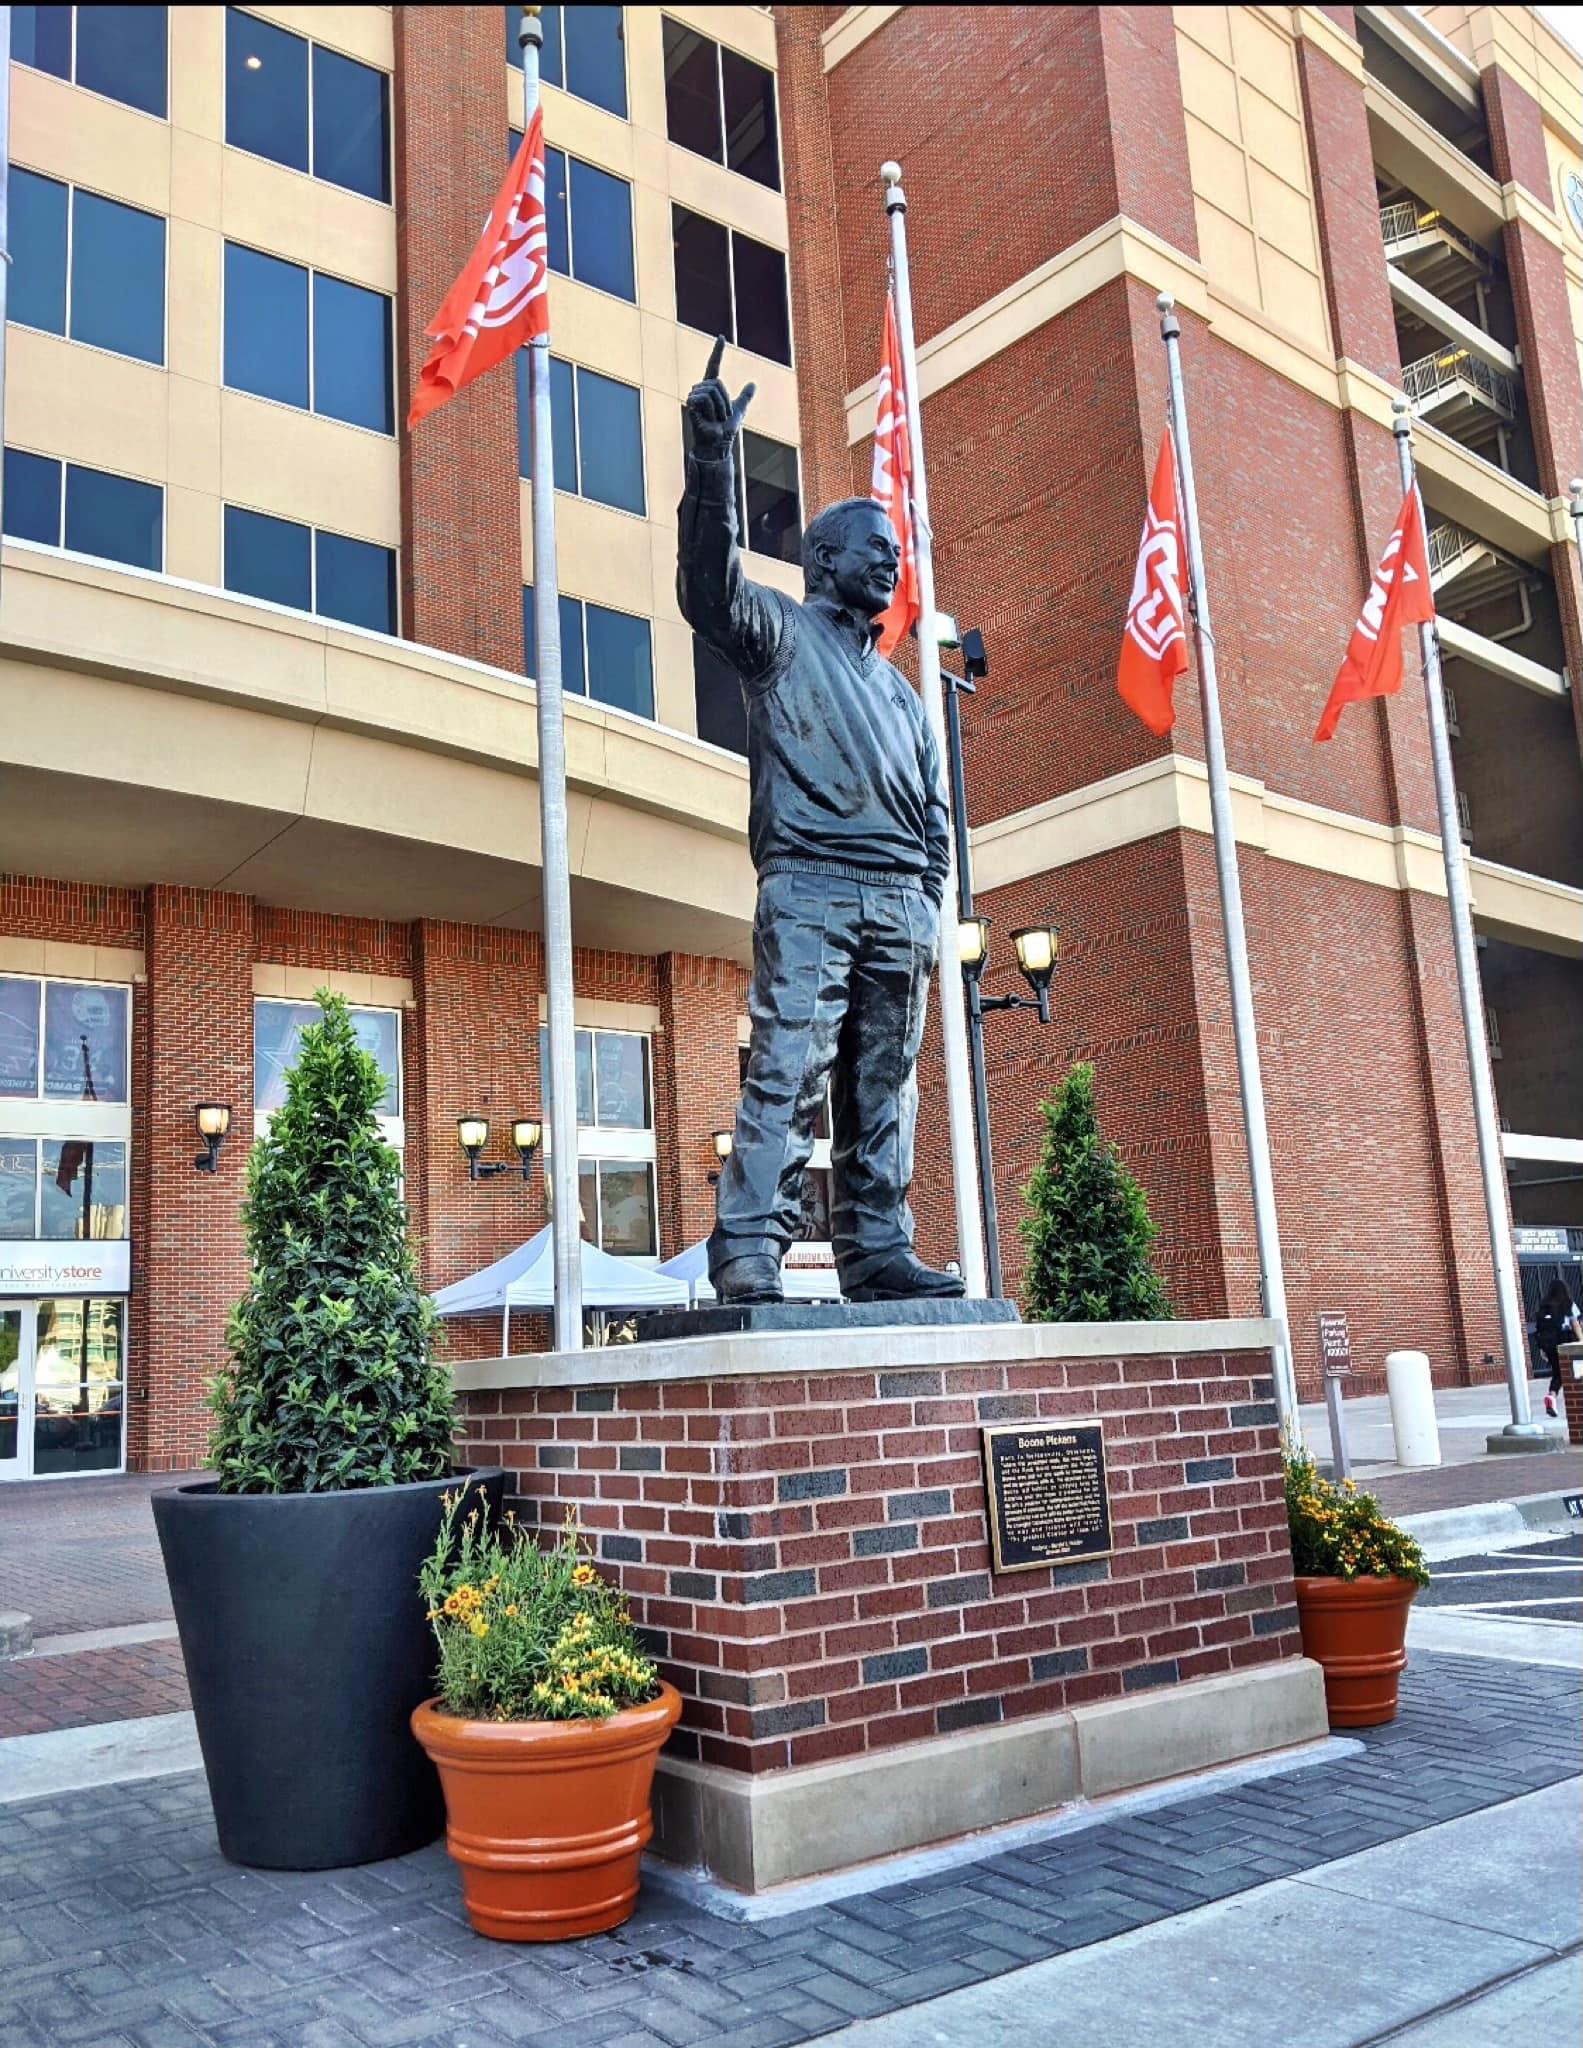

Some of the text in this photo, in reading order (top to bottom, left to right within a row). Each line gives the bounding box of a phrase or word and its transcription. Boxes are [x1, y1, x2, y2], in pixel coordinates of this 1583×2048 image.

[0, 1264, 102, 1281] niversitystore
[1018, 1434, 1077, 1449] Boone Pickens
